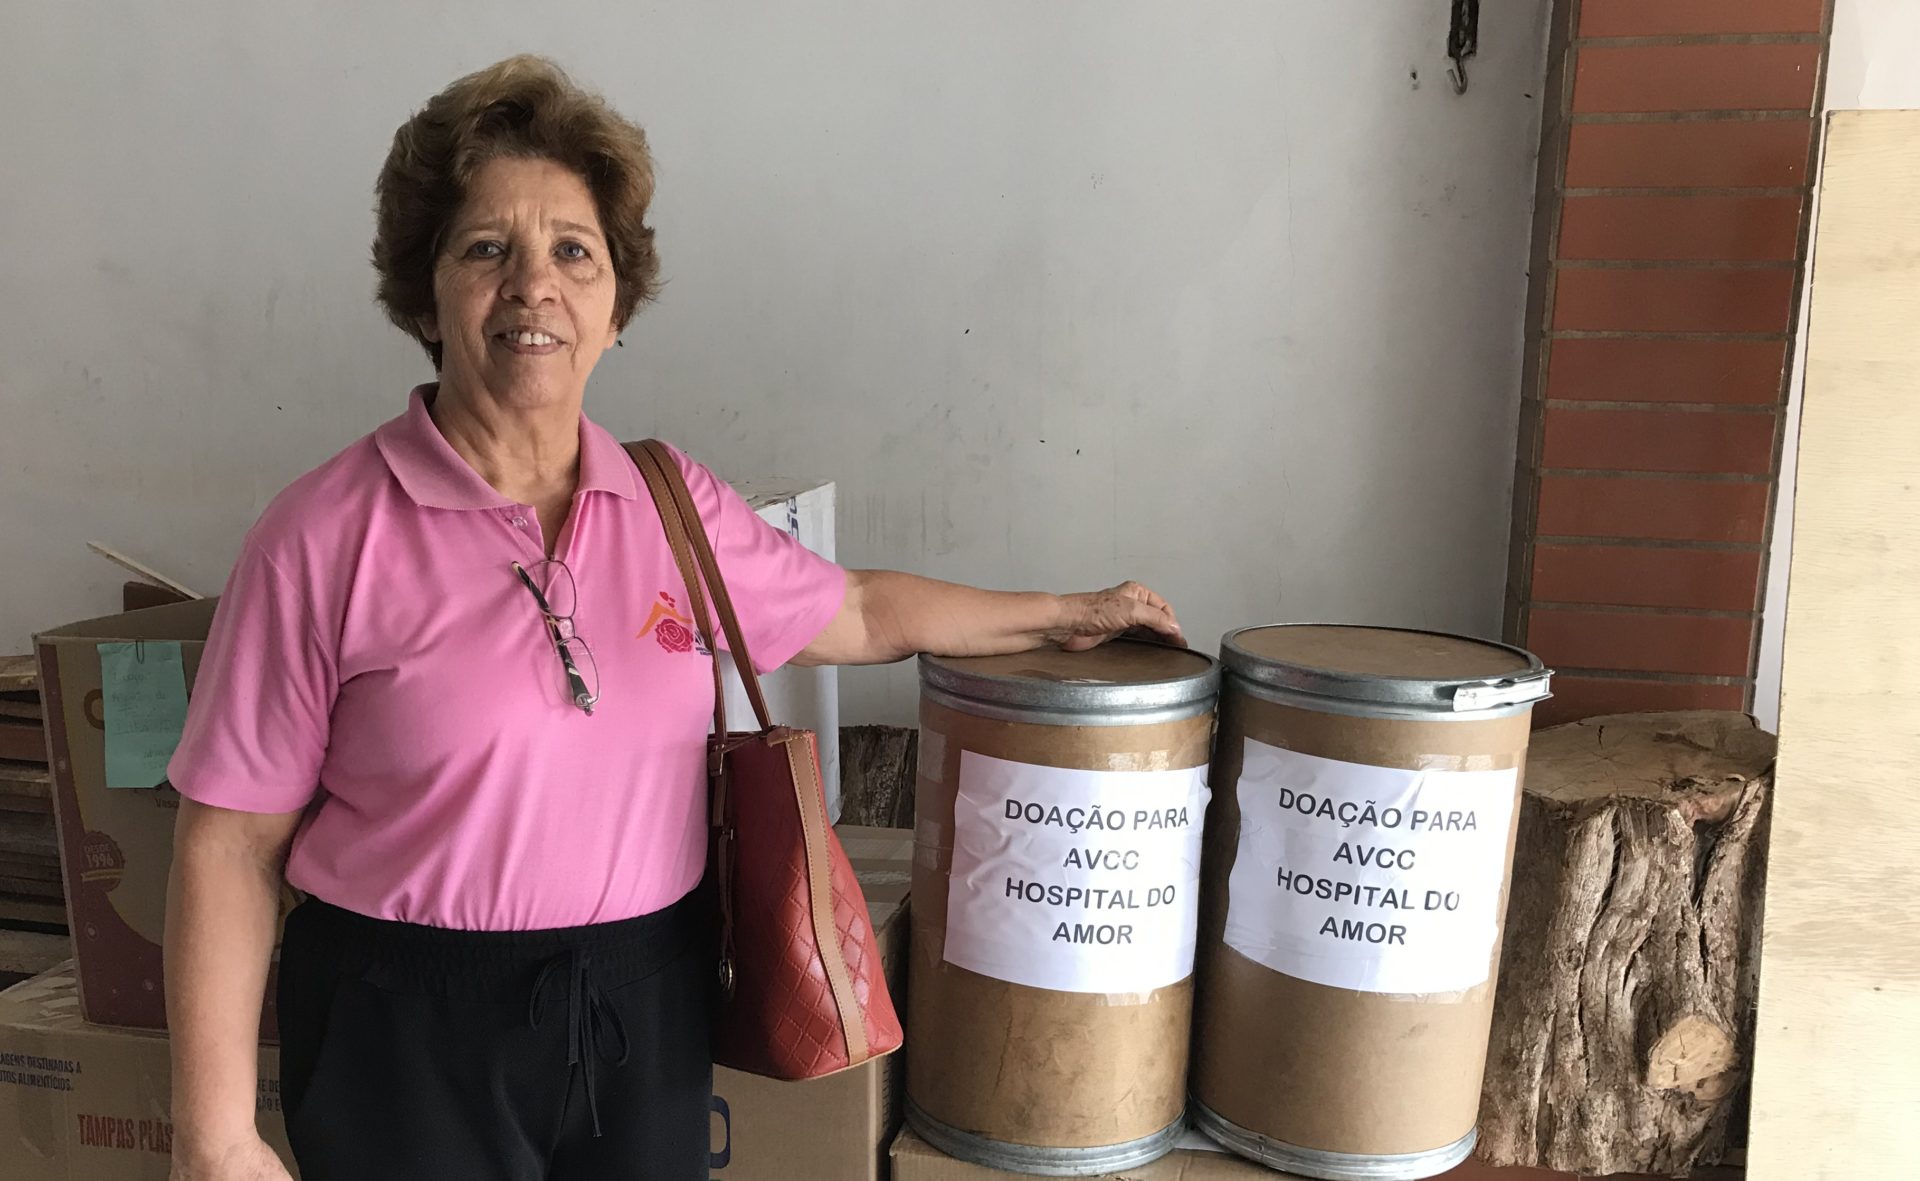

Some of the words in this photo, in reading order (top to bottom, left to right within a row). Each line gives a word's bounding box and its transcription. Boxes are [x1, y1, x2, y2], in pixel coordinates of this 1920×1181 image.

[1004, 799, 1125, 833] DOAÇÃO
[1133, 807, 1189, 830] PARA
[1279, 787, 1401, 828] DOAÇÃO
[1410, 810, 1477, 831] PARA
[86, 853, 114, 868] 1996
[1063, 848, 1139, 870] AVCC
[1333, 842, 1416, 870] AVCC
[1005, 877, 1140, 909] HOSPITAL
[1147, 885, 1176, 907] DO
[1277, 867, 1415, 910] HOSPITAL
[1424, 890, 1460, 911] DO
[1052, 922, 1133, 944] AMOR
[1319, 916, 1407, 945] AMOR
[27, 1055, 74, 1075] DESTINADAS
[75, 1060, 83, 1075] A
[77, 1113, 136, 1150] TAMPAS
